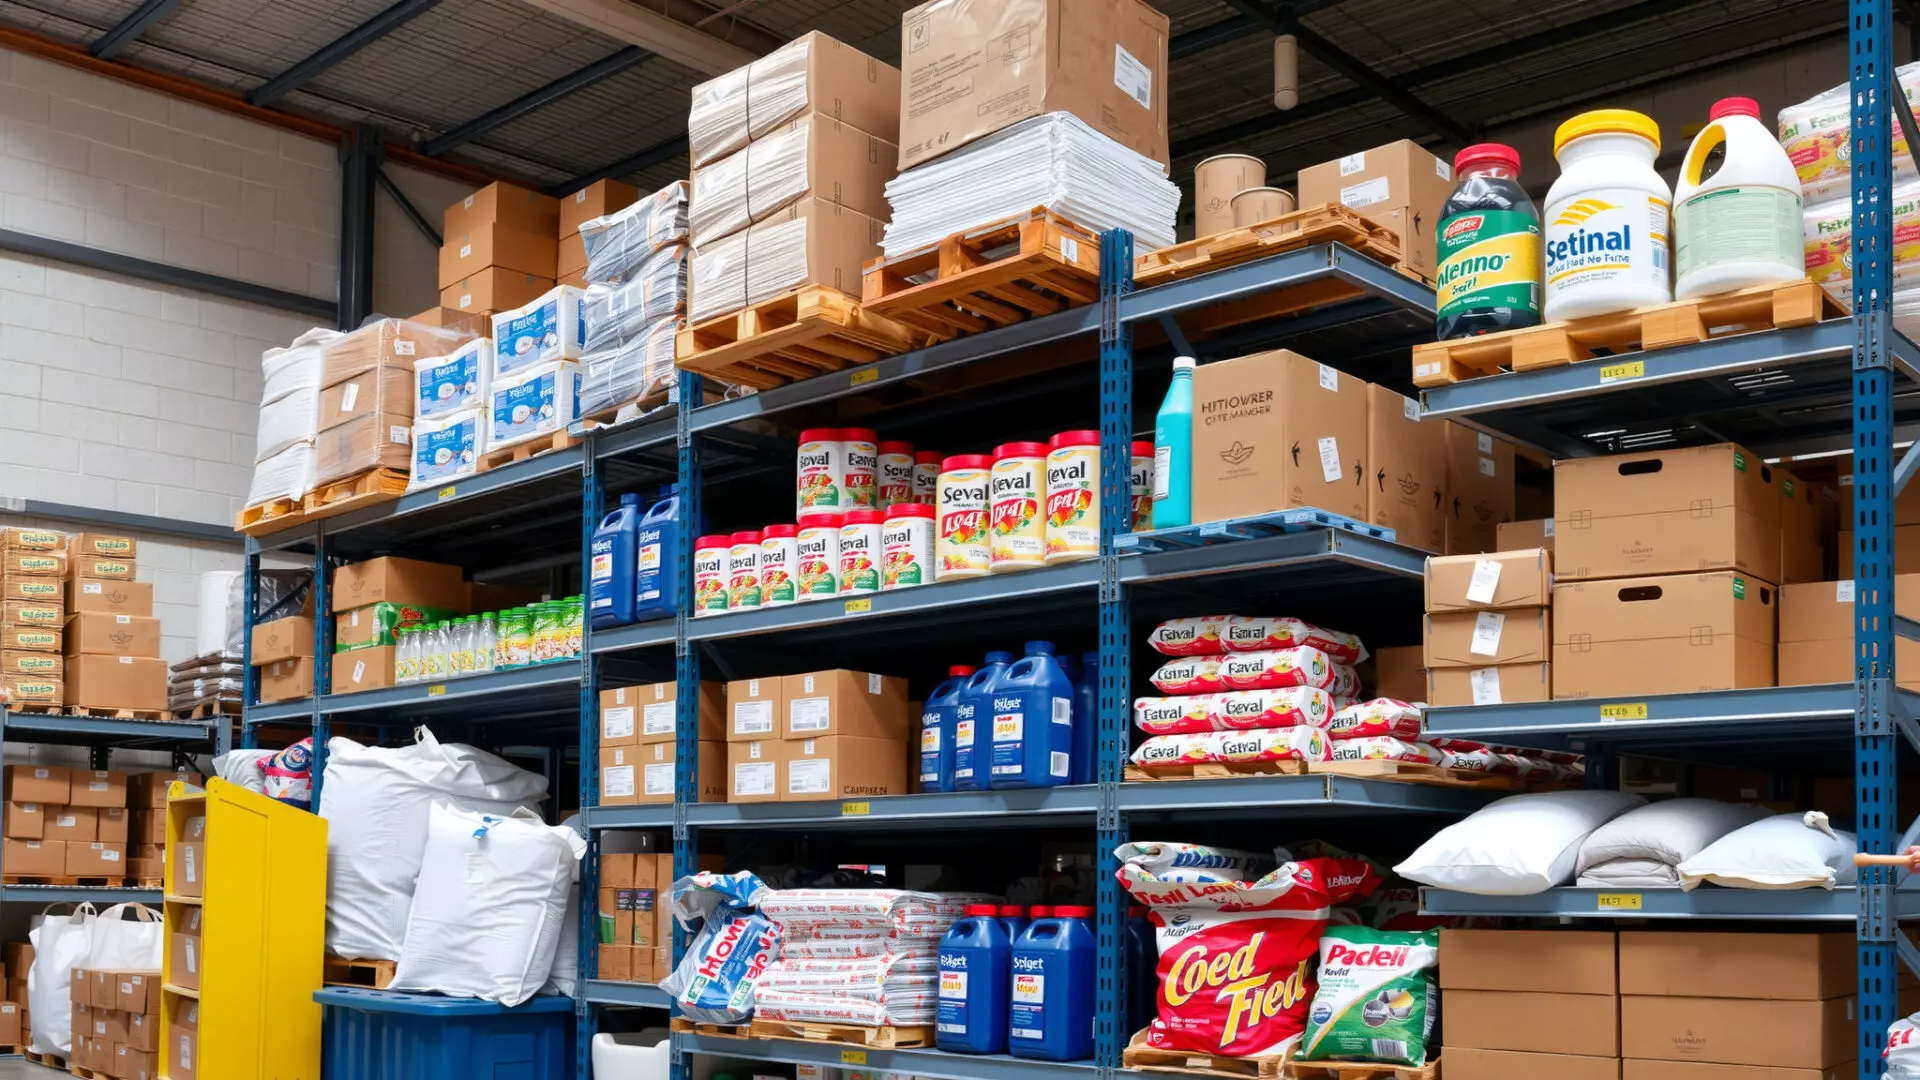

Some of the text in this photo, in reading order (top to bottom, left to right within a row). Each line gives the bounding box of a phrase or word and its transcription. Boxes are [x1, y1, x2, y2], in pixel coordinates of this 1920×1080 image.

[1546, 224, 1631, 268] Setinal
[942, 483, 990, 504] Seval
[1165, 931, 1266, 1007] Coed
